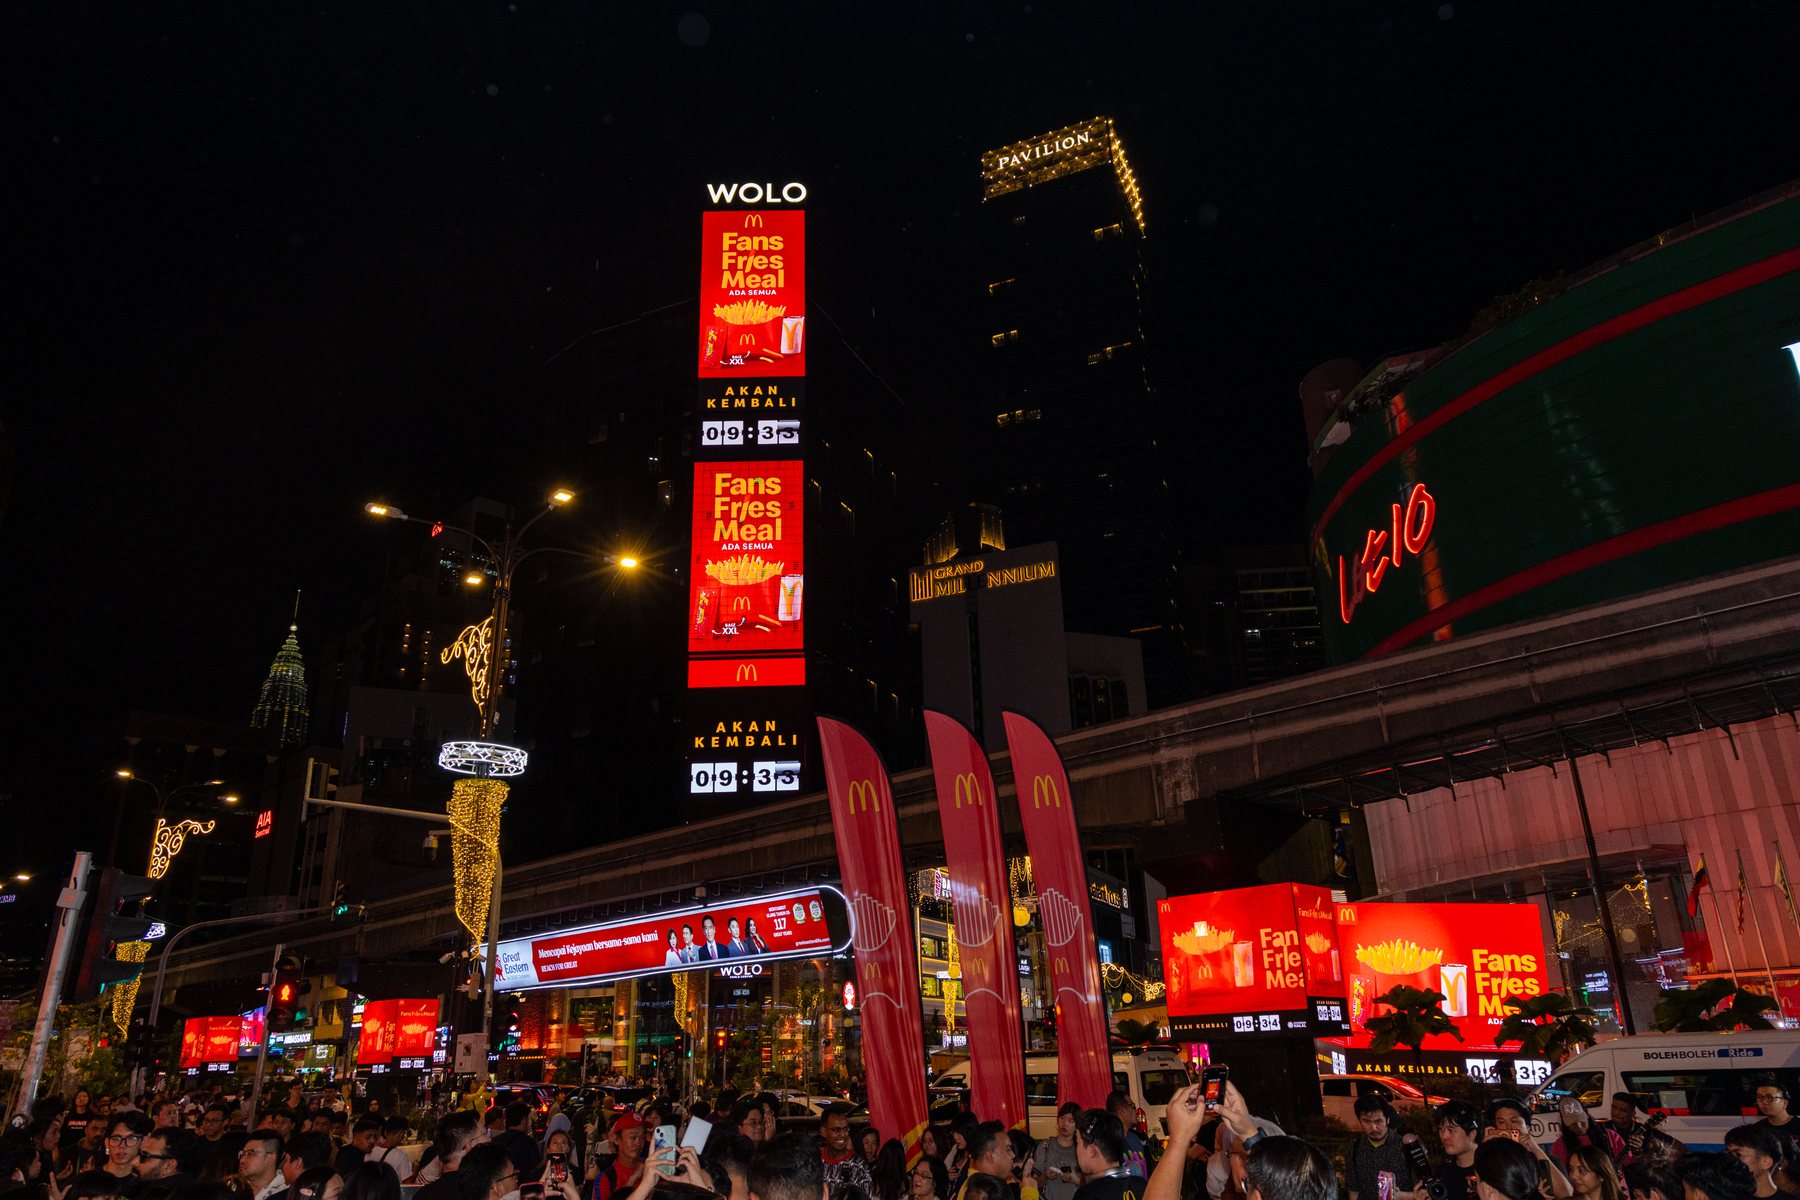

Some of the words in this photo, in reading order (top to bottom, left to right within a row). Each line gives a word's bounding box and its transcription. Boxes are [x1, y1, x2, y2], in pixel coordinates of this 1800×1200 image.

[999, 131, 1090, 169] PAVILION
[707, 183, 807, 203] WOLO
[722, 232, 784, 251] Fans
[721, 269, 784, 289] Meal
[725, 386, 778, 396] AKAN
[707, 397, 796, 408] KEMBALI
[714, 473, 782, 496] Fans
[713, 518, 782, 542] Meal
[721, 543, 740, 551] ADA
[742, 542, 774, 550] SEMUA
[934, 560, 984, 580] GRAND
[716, 720, 776, 732] AKAN
[694, 734, 797, 748] KEMBALI
[256, 810, 271, 829] AIA
[774, 917, 786, 930] 117
[641, 930, 658, 942] kami
[502, 952, 520, 963] Great
[1472, 948, 1537, 972] Fans
[504, 963, 529, 974] Eastern
[720, 964, 762, 976] WOLO
[1235, 1017, 1279, 1030] 09:34
[1728, 1048, 1754, 1057] Ride
[1356, 1064, 1391, 1072] AKAN
